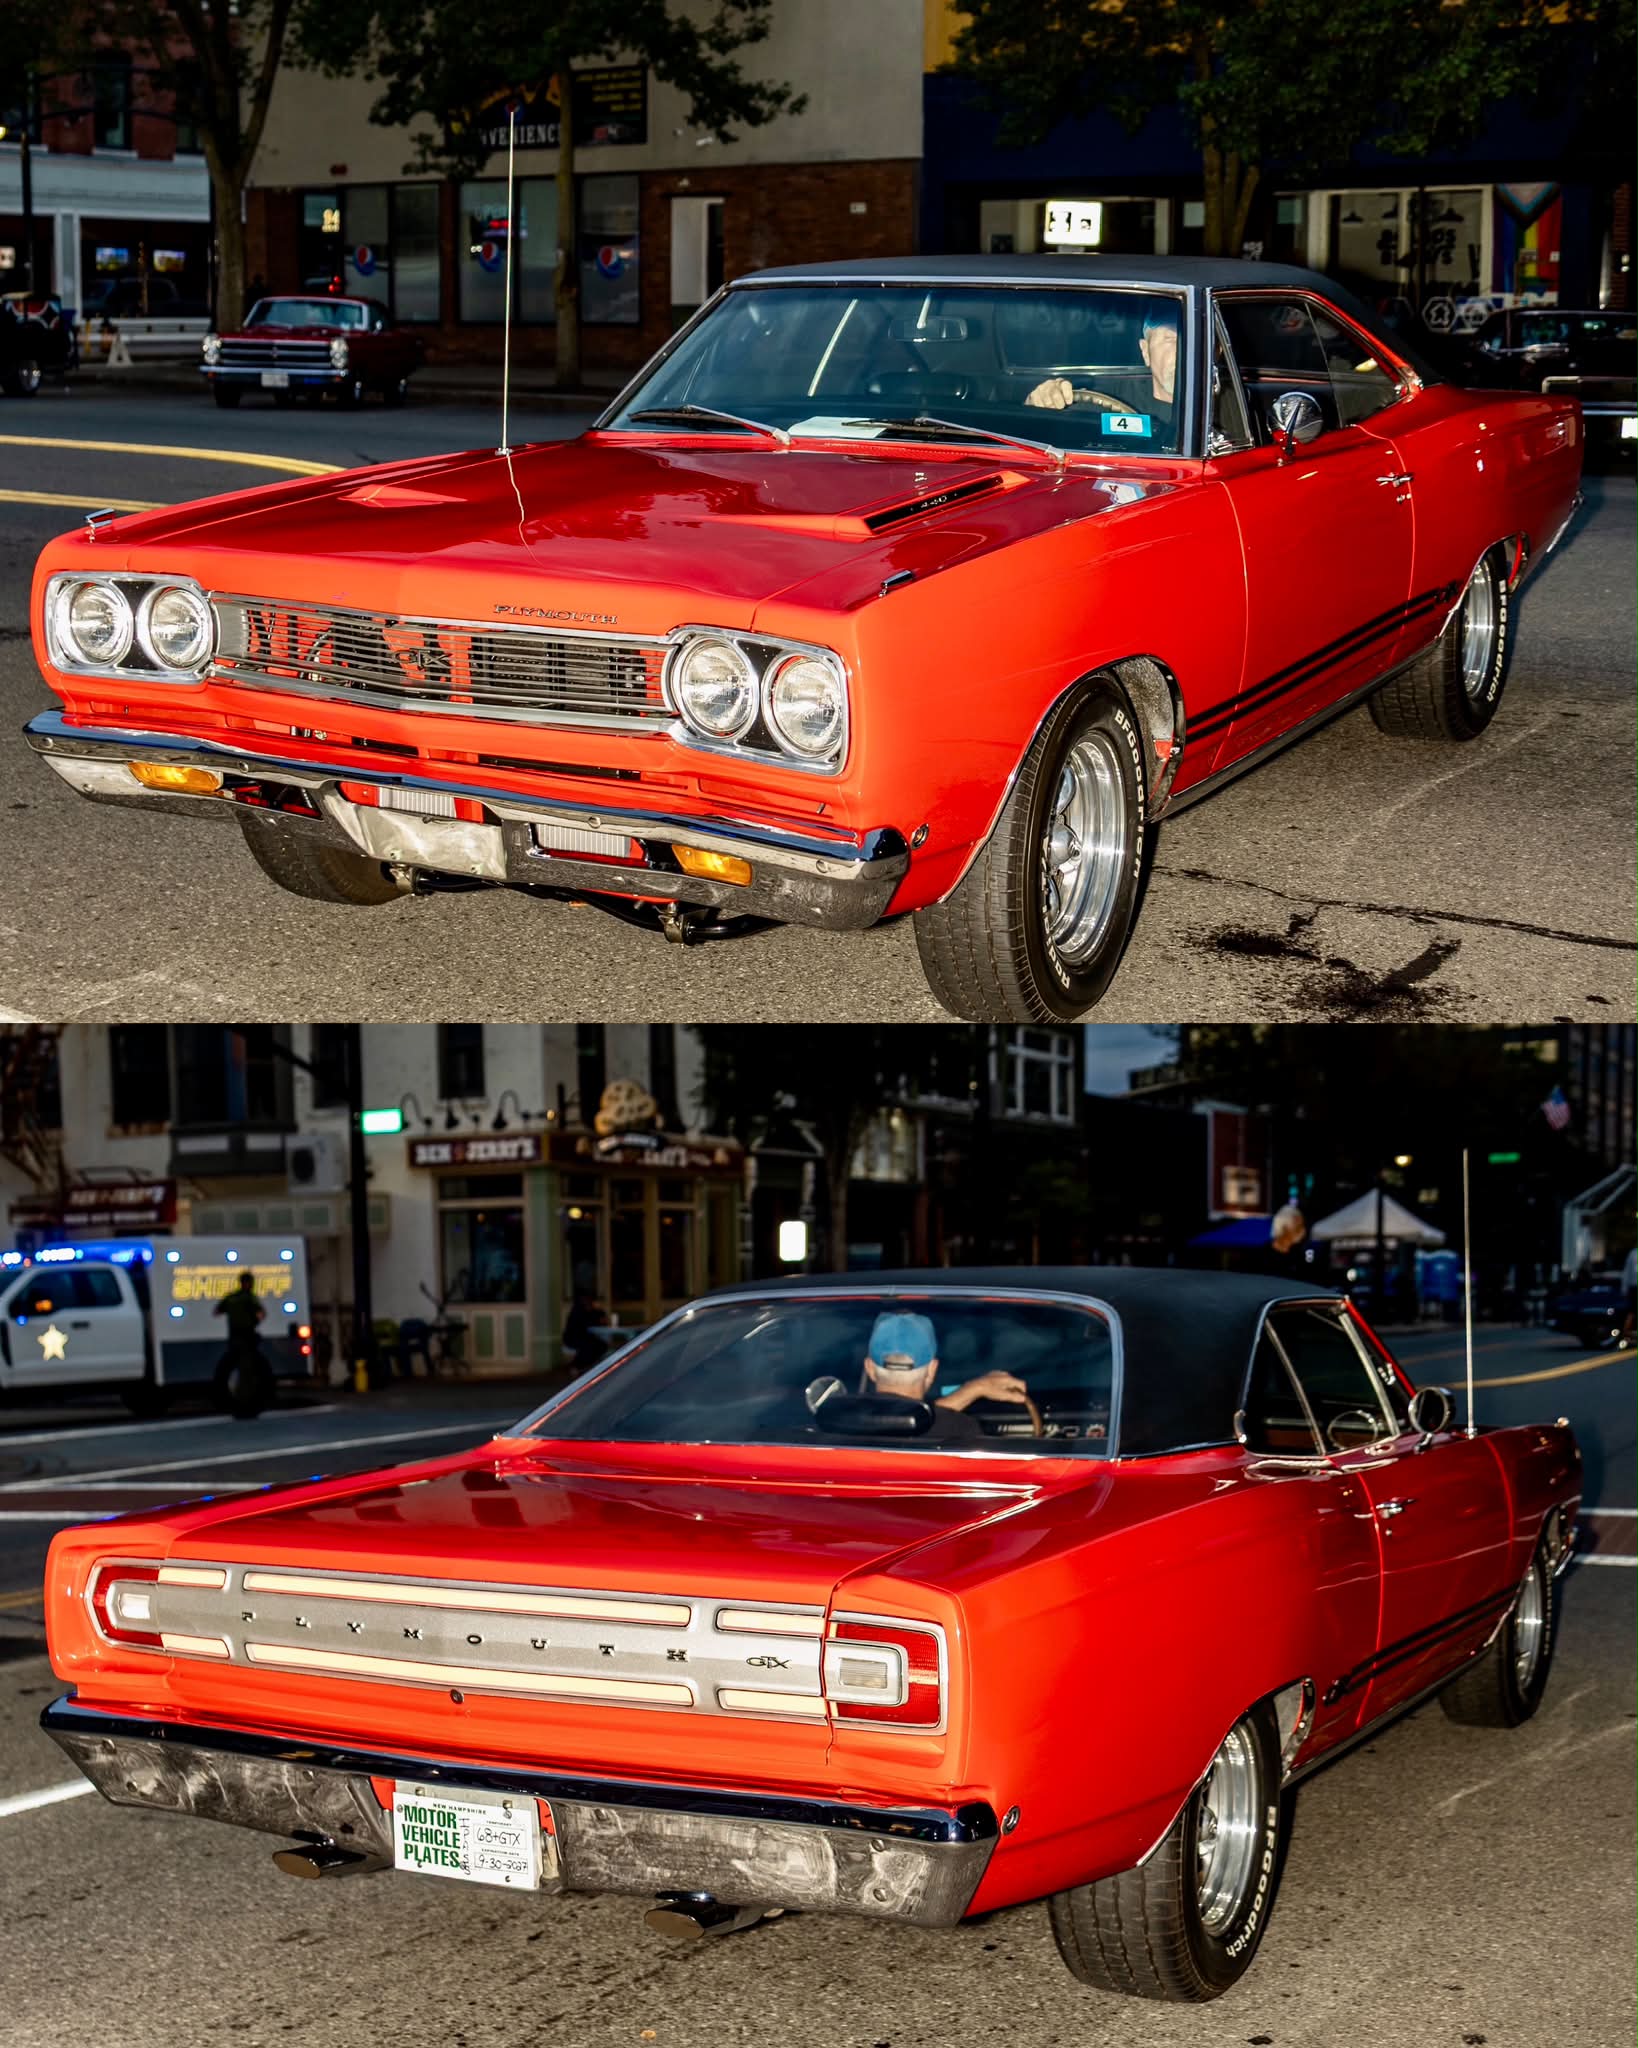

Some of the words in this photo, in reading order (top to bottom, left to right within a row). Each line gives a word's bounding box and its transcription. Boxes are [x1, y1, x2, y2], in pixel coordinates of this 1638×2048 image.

[1116, 417, 1129, 430] 4
[493, 603, 618, 625] PLYMOUTH
[242, 1611, 688, 1663] PLYMOUTH
[745, 1655, 791, 1670] GTX
[403, 1804, 457, 1830] MOTOR
[433, 1802, 448, 1810] NEW
[448, 1805, 487, 1816] HAMPSHIRE
[402, 1823, 461, 1850] VEHICLE
[476, 1826, 521, 1847] 68+GTX
[403, 1843, 461, 1869] PLATES
[1225, 1805, 1278, 1959] BFGoodrich
